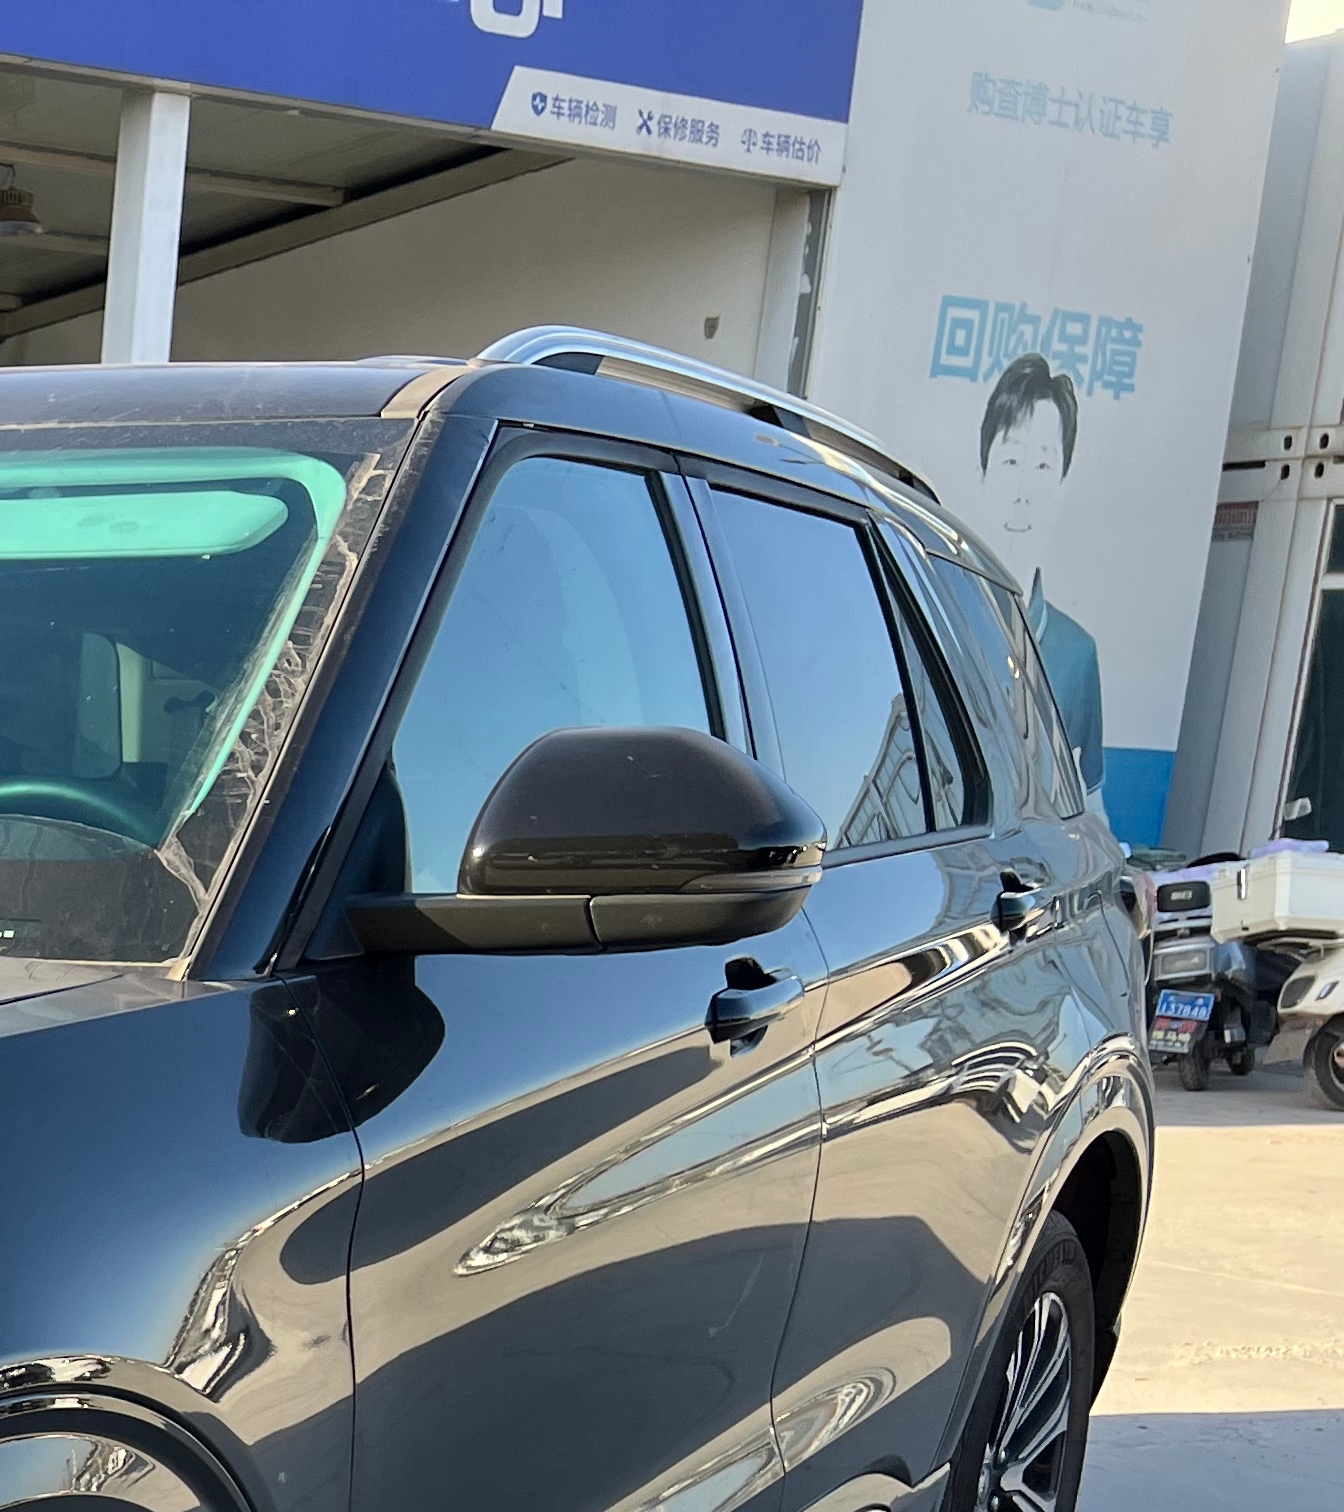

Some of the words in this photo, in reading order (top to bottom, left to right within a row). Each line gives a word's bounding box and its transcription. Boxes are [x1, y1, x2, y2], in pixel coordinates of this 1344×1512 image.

[550, 93, 618, 132] 车辆检测
[656, 113, 722, 149] 保修服务
[759, 130, 823, 165] 车辆估价
[966, 70, 1175, 150] 购查博士认证车享
[929, 294, 1145, 402] 回购保障
